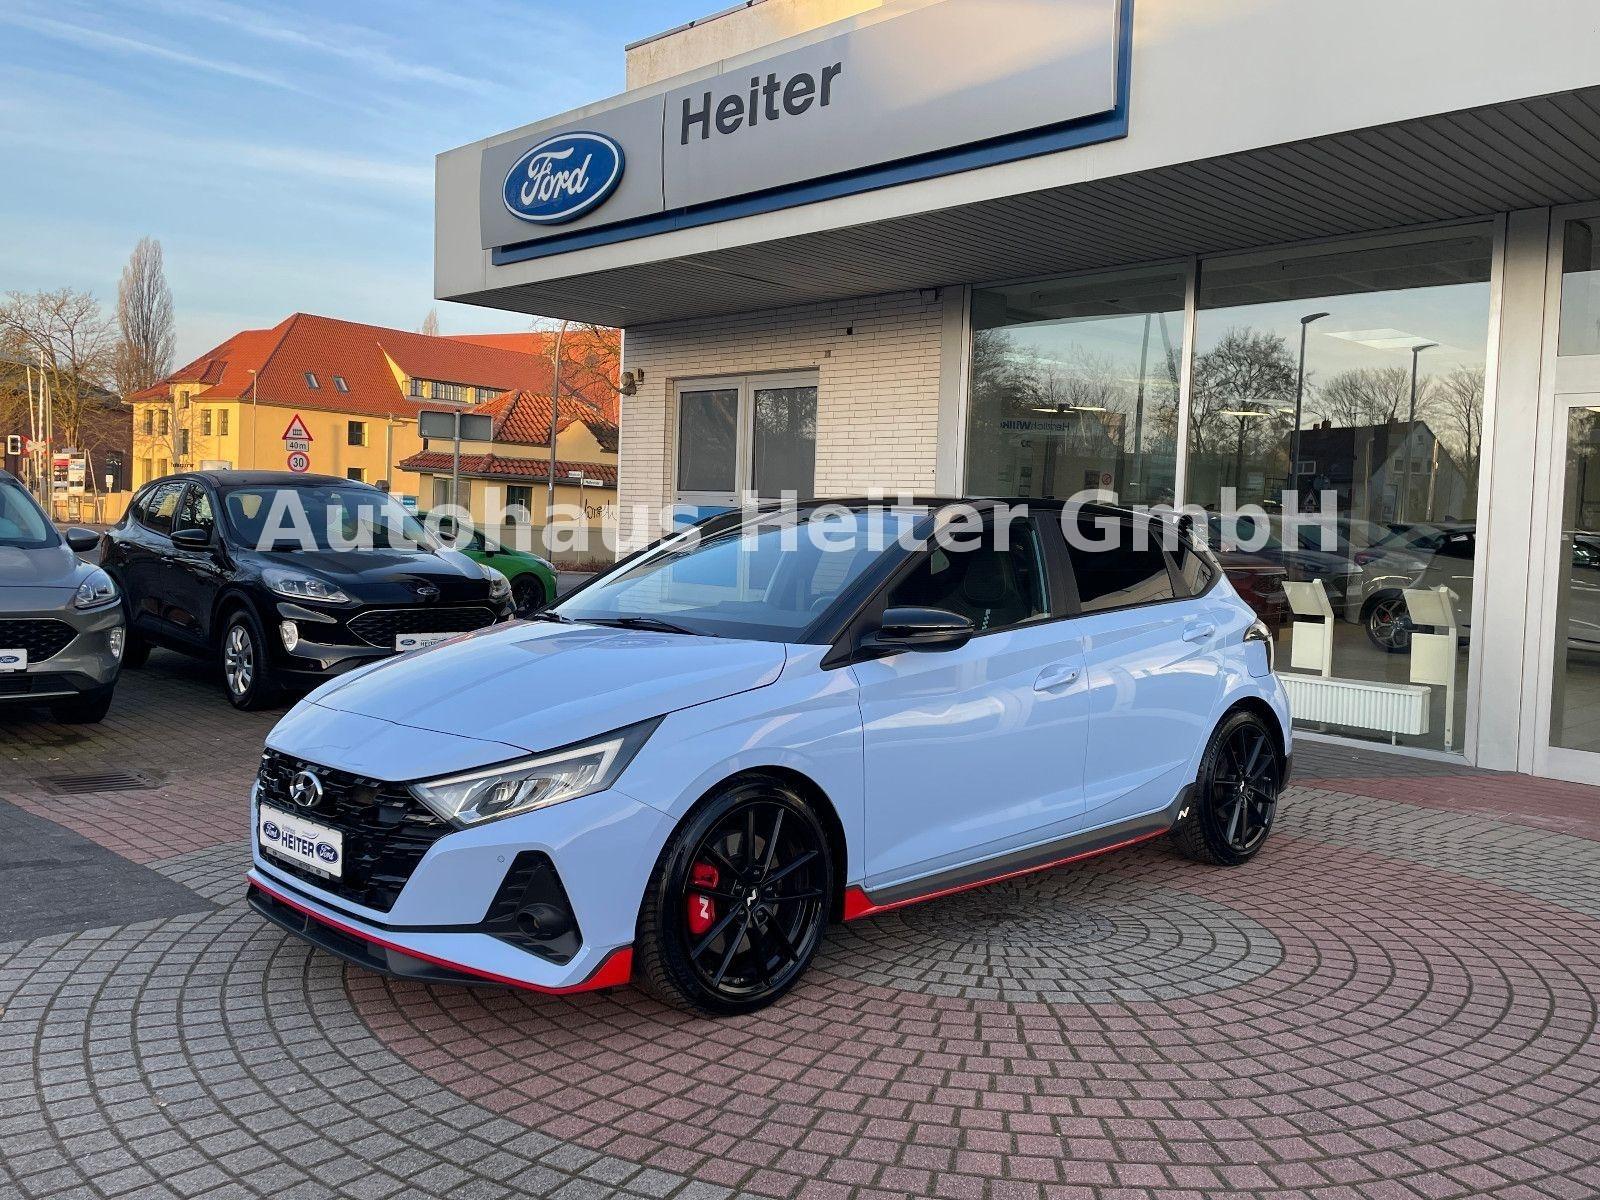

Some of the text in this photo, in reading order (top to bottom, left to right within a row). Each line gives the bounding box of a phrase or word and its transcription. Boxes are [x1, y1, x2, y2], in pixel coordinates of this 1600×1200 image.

[680, 61, 842, 146] Heiter
[293, 457, 304, 467] 30
[281, 830, 315, 859] HEITER
